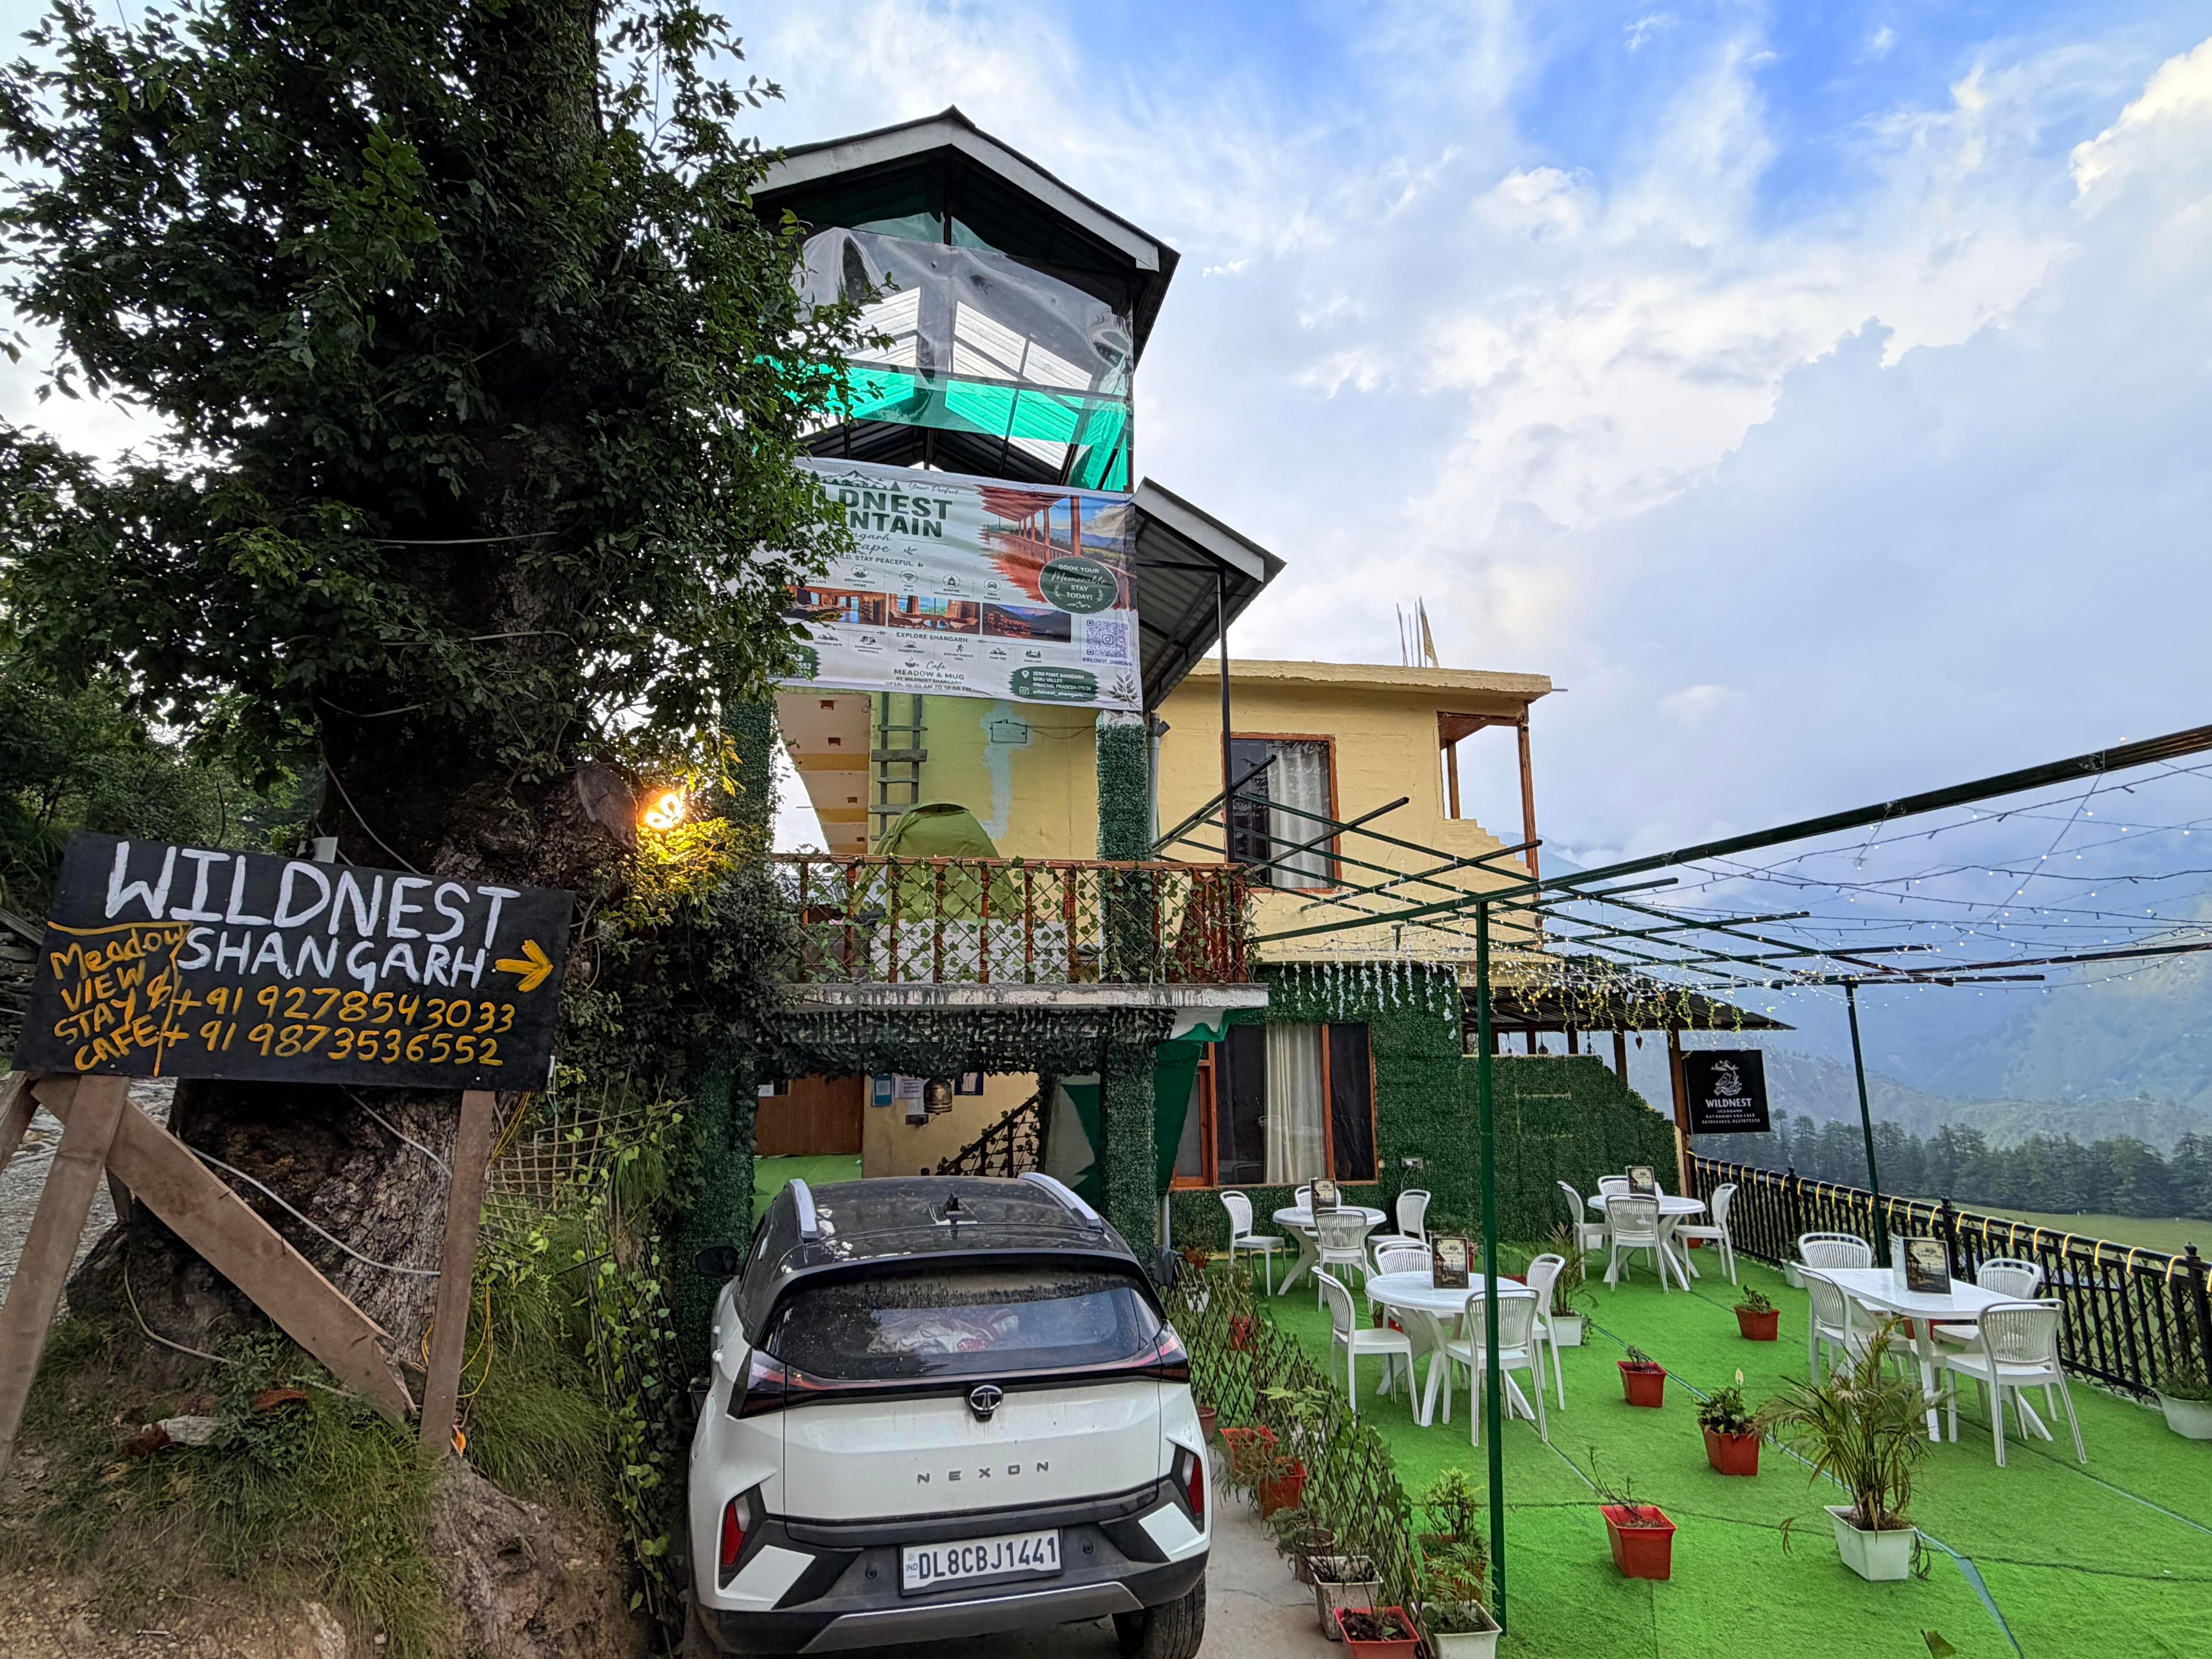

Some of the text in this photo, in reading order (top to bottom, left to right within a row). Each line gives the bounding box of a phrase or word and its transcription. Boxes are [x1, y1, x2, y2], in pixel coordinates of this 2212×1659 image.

[1066, 592, 1092, 600] TODAY!
[105, 841, 521, 950] WILDNEST
[177, 927, 486, 993] SHANGARH
[60, 959, 146, 1013] VIEW
[257, 985, 515, 1033] 9278543033
[54, 987, 136, 1045] STAY
[74, 1014, 159, 1071] CAFE
[248, 1023, 503, 1065] 9873536552
[1705, 1098, 1752, 1108] WILDNEST
[917, 1461, 1048, 1484] NEXON
[919, 1537, 1056, 1580] DL8CBJ1441
